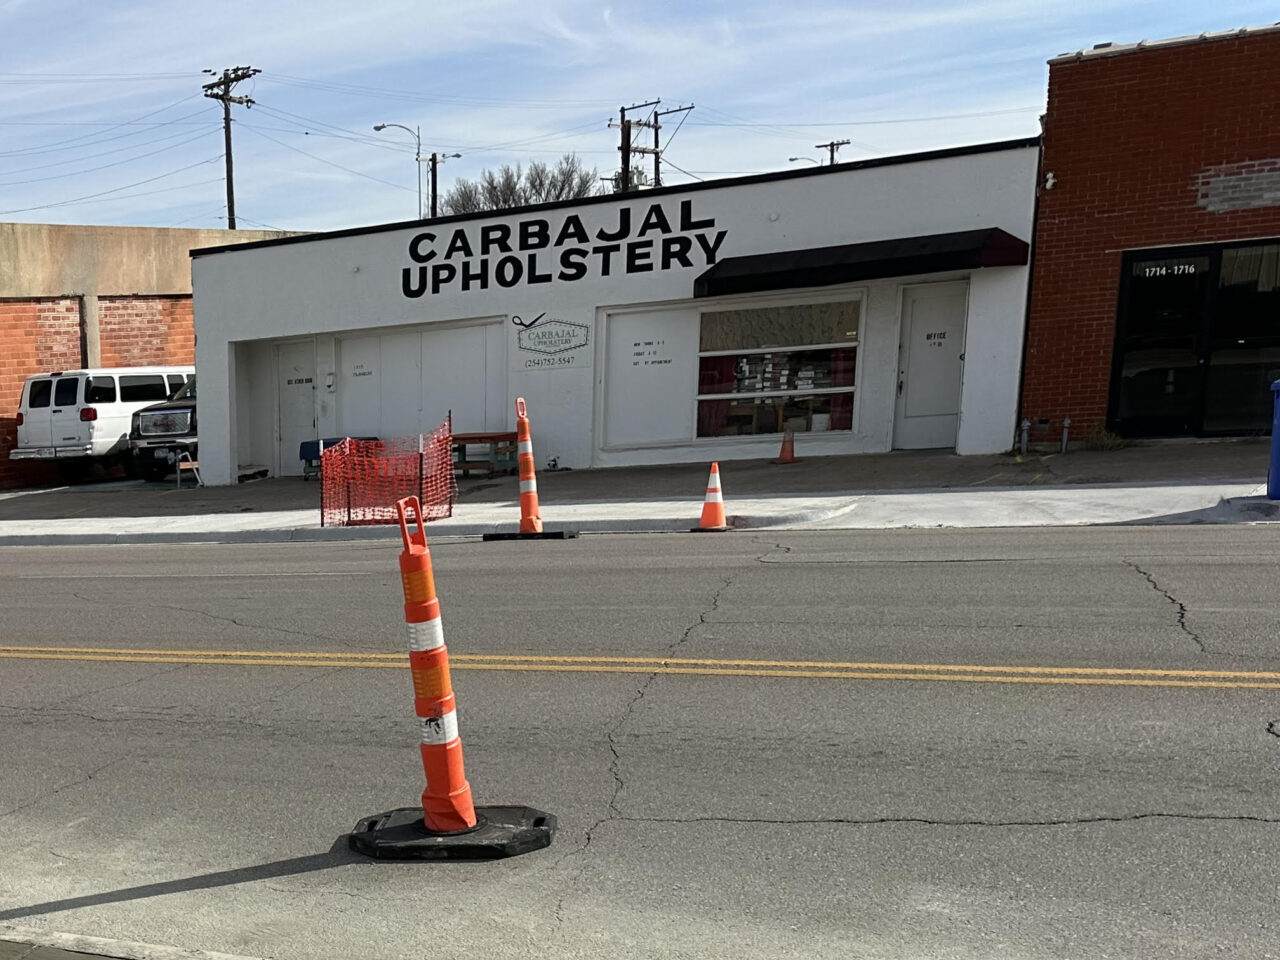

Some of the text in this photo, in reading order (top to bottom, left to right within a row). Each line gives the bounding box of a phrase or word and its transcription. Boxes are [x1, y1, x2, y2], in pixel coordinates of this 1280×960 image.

[408, 199, 716, 264] CARBAJAL
[402, 230, 728, 299] UPHOLSTERY
[1145, 267, 1166, 277] 1714
[1173, 264, 1195, 275] 1716
[528, 329, 578, 341] CARBAJAL
[525, 356, 575, 369] (254)752-5547
